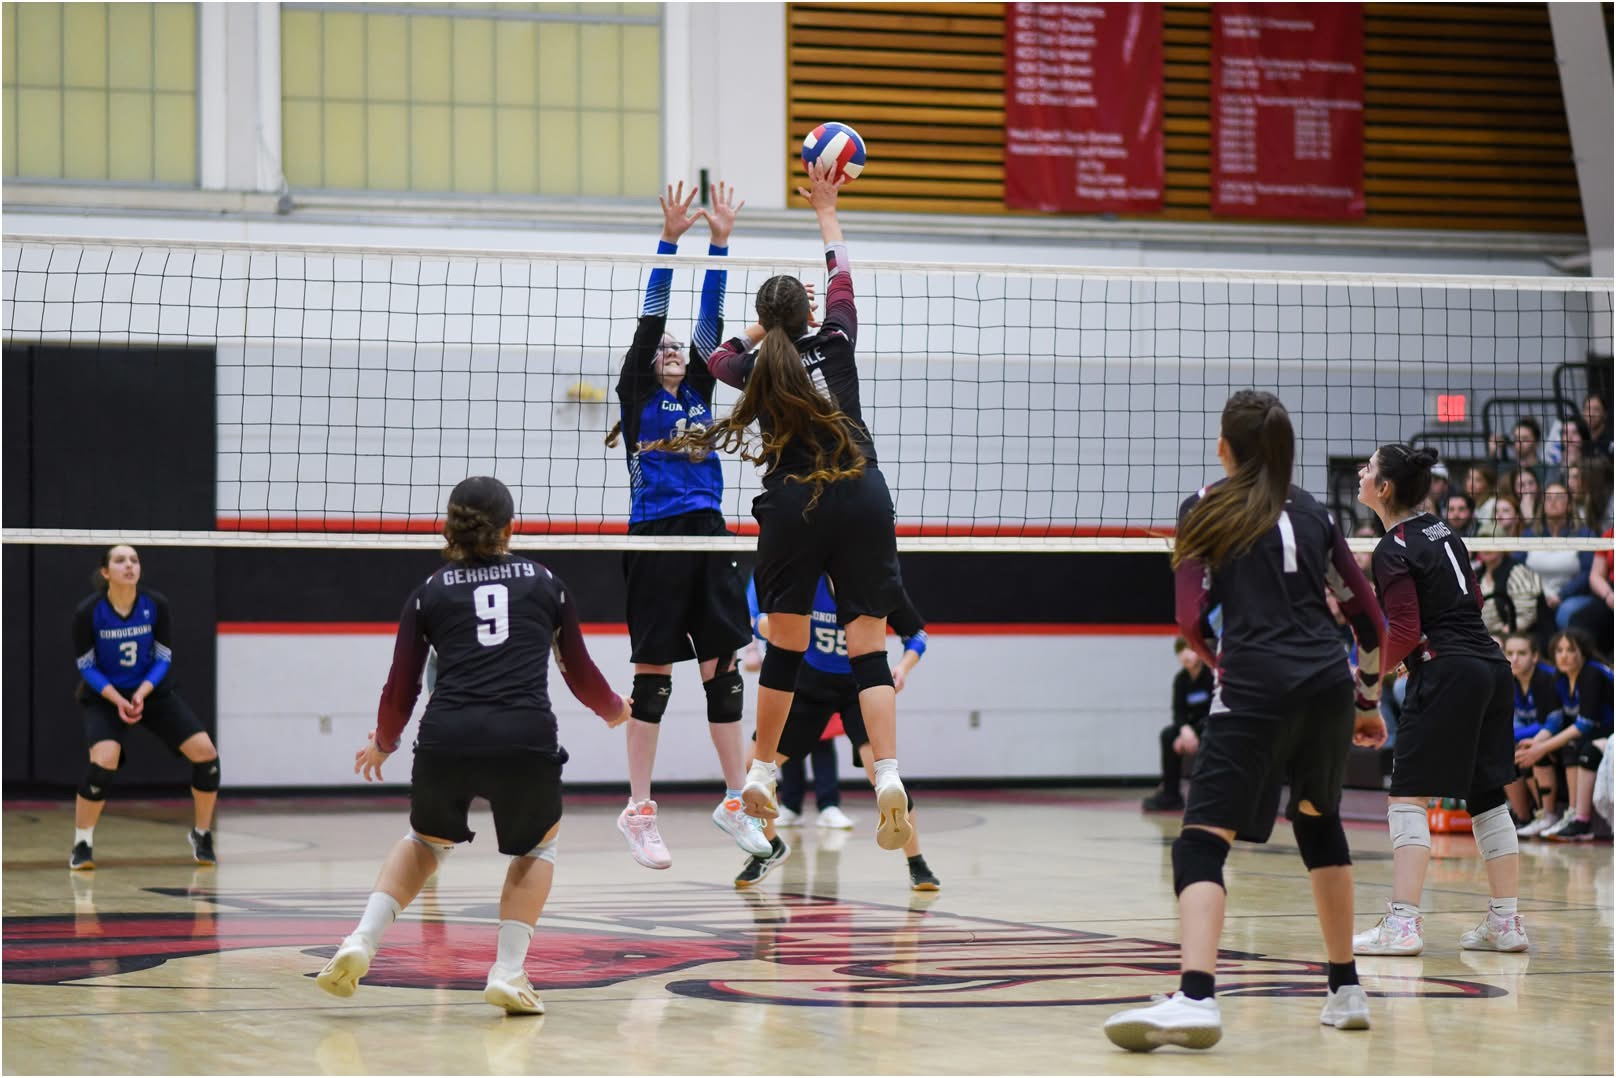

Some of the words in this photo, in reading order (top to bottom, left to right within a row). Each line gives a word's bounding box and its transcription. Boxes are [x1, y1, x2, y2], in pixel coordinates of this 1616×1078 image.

[1277, 510, 1299, 573] 1
[1443, 541, 1469, 595] 1
[443, 562, 536, 586] GERAGHTY
[473, 583, 510, 647] 9
[119, 640, 138, 667] 3
